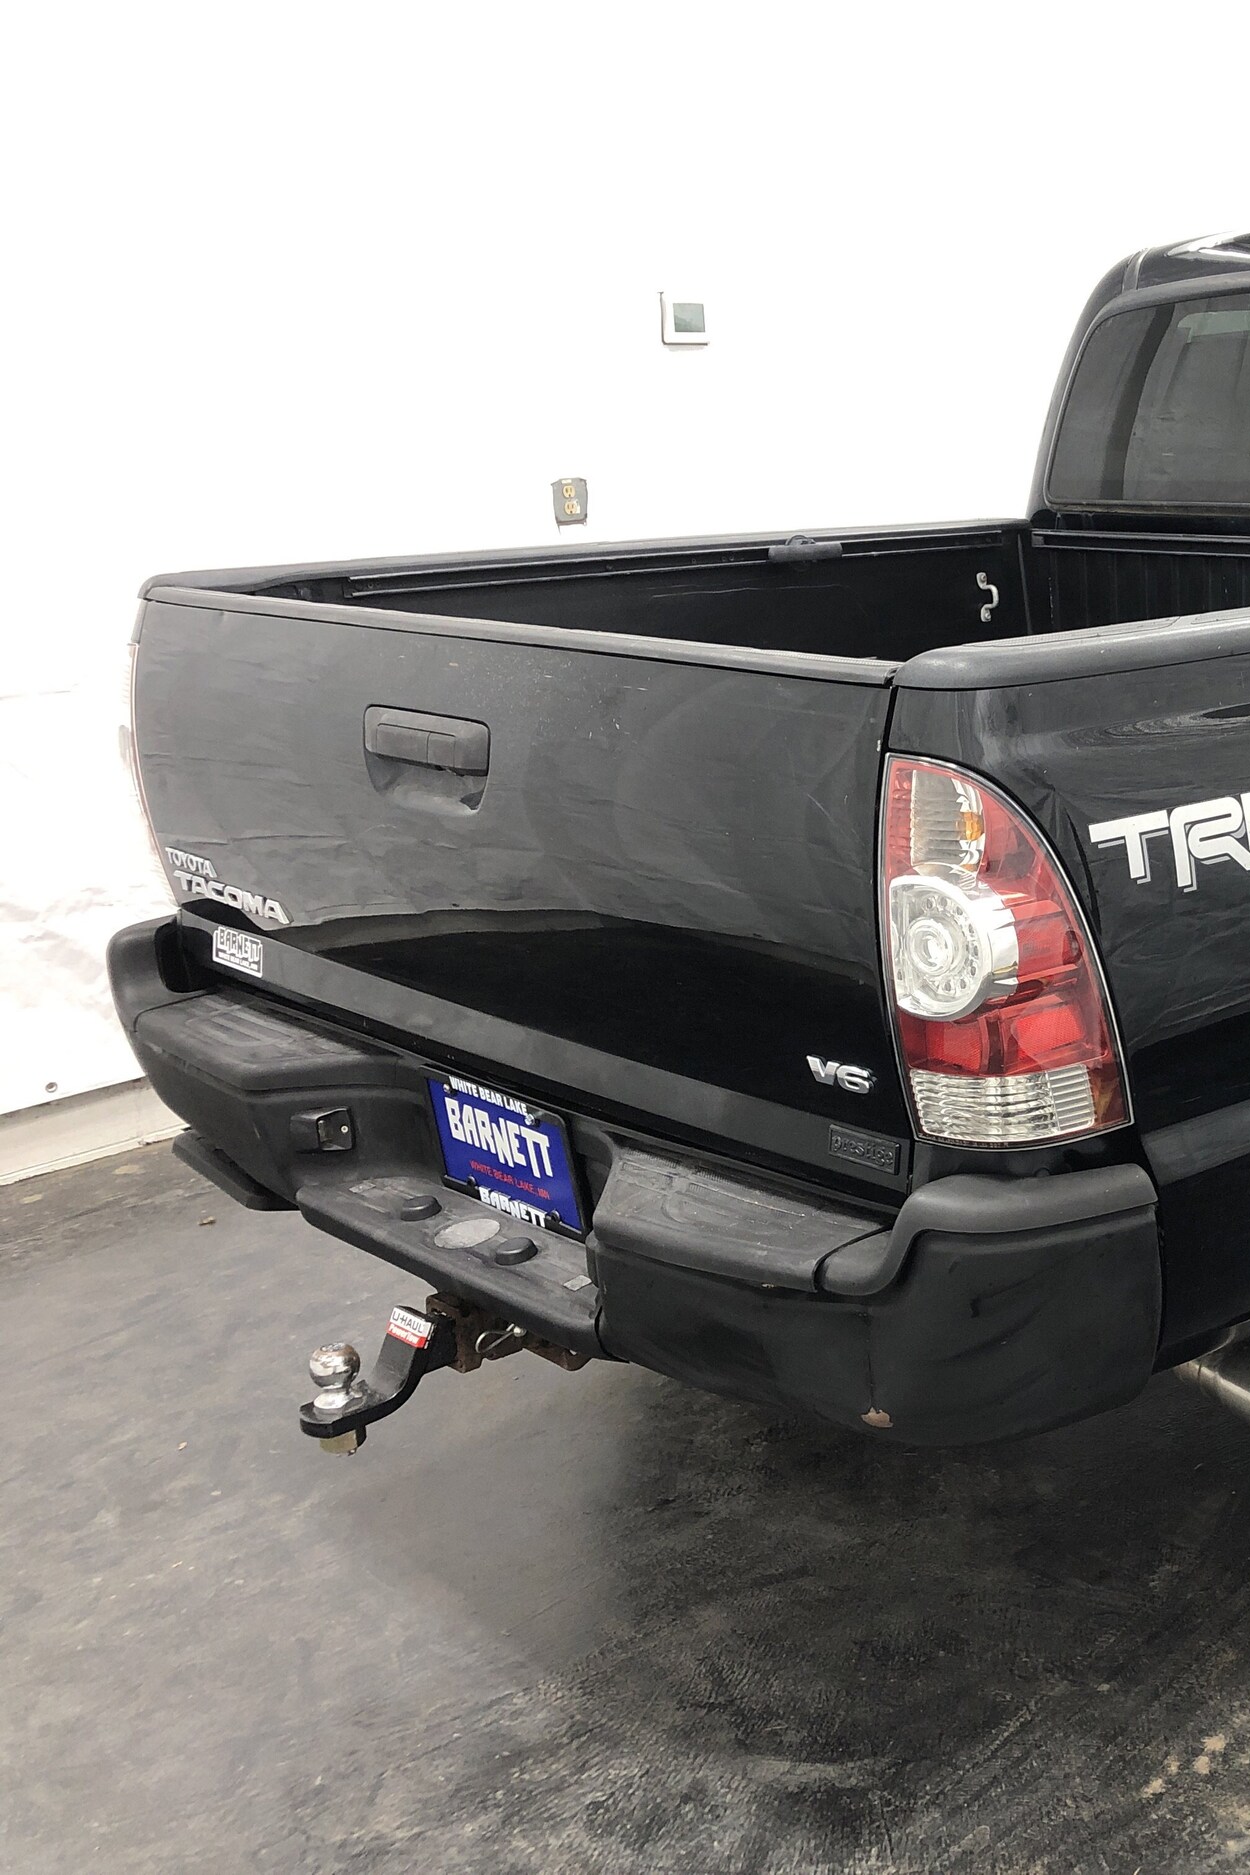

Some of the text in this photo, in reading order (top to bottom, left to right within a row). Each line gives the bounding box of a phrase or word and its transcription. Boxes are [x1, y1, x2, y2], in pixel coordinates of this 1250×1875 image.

[165, 846, 217, 878] TOYOTA
[173, 869, 293, 925] TACOMA
[806, 1055, 872, 1094] V6
[449, 1075, 528, 1116] WHITE BEAR LAKE
[444, 1096, 553, 1178] BARNETT
[478, 1186, 548, 1228] BARNETT
[392, 1310, 423, 1334] U-HAUL
